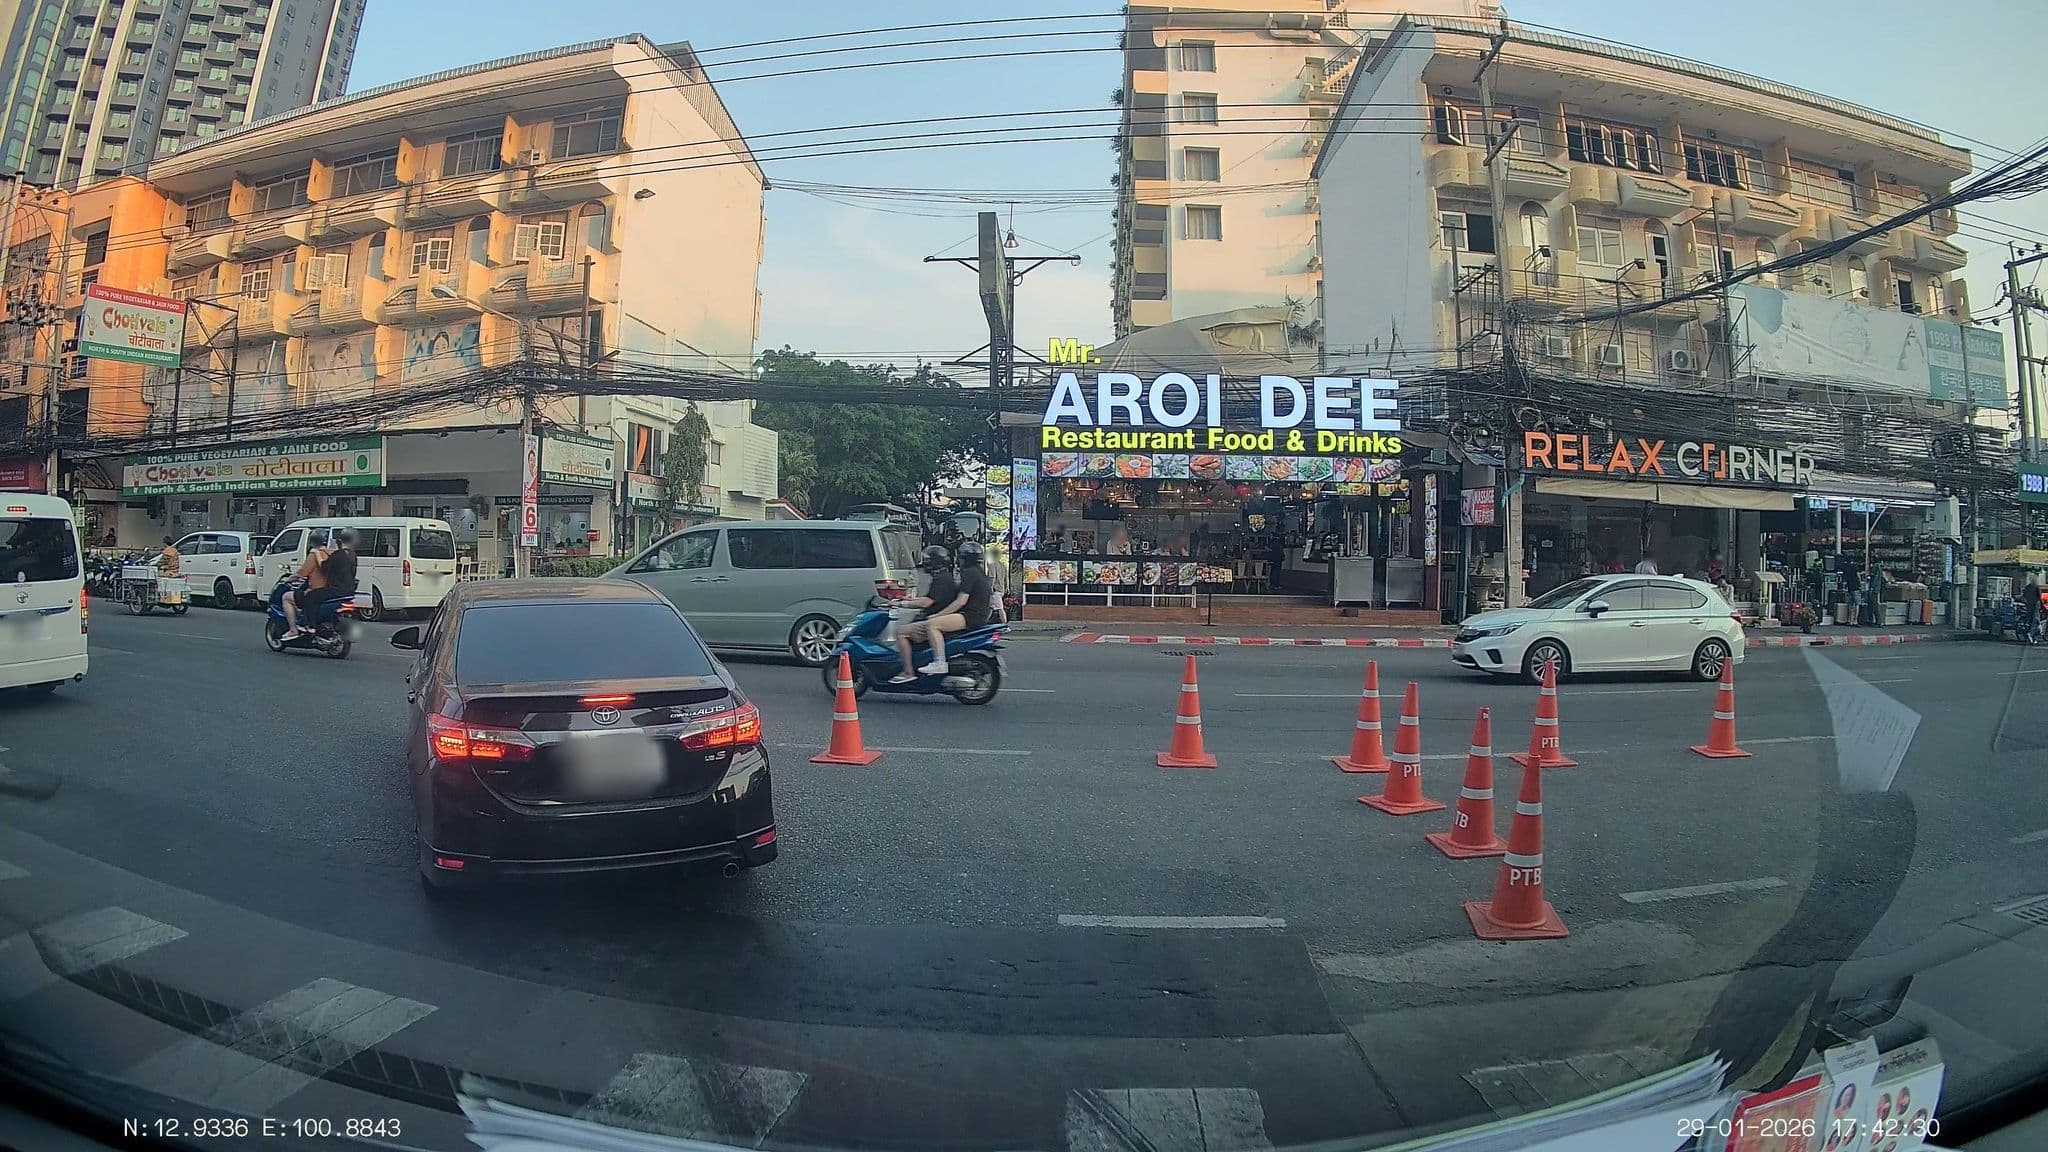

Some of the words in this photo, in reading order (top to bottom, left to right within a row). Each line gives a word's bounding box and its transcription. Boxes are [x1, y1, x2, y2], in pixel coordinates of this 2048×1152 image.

[1049, 337, 1101, 364] Mr.
[1929, 330, 1951, 348] 1988
[1953, 335, 2001, 357] PARMACY
[1041, 372, 1222, 427] AROI
[1260, 375, 1401, 431] DEE
[1042, 426, 1196, 450] Restaurant
[1208, 428, 1274, 451] Food
[1286, 429, 1306, 452] &
[1317, 430, 1402, 454] Drinks
[147, 455, 173, 464] 100%
[174, 452, 199, 462] PURE
[201, 447, 267, 460] VEGETARIAN
[269, 446, 279, 455] &
[281, 444, 310, 455] JAIN
[312, 441, 349, 453] FOOD
[1524, 431, 1665, 475] RELAX
[241, 457, 348, 477] चोटीवाला
[144, 483, 174, 494] North
[176, 483, 186, 493] &
[189, 481, 222, 492] South
[225, 480, 266, 490] Indian
[269, 477, 349, 488] Restaurant
[2021, 473, 2043, 492] 1988
[526, 506, 536, 527] 6
[1510, 867, 1542, 886] PTB
